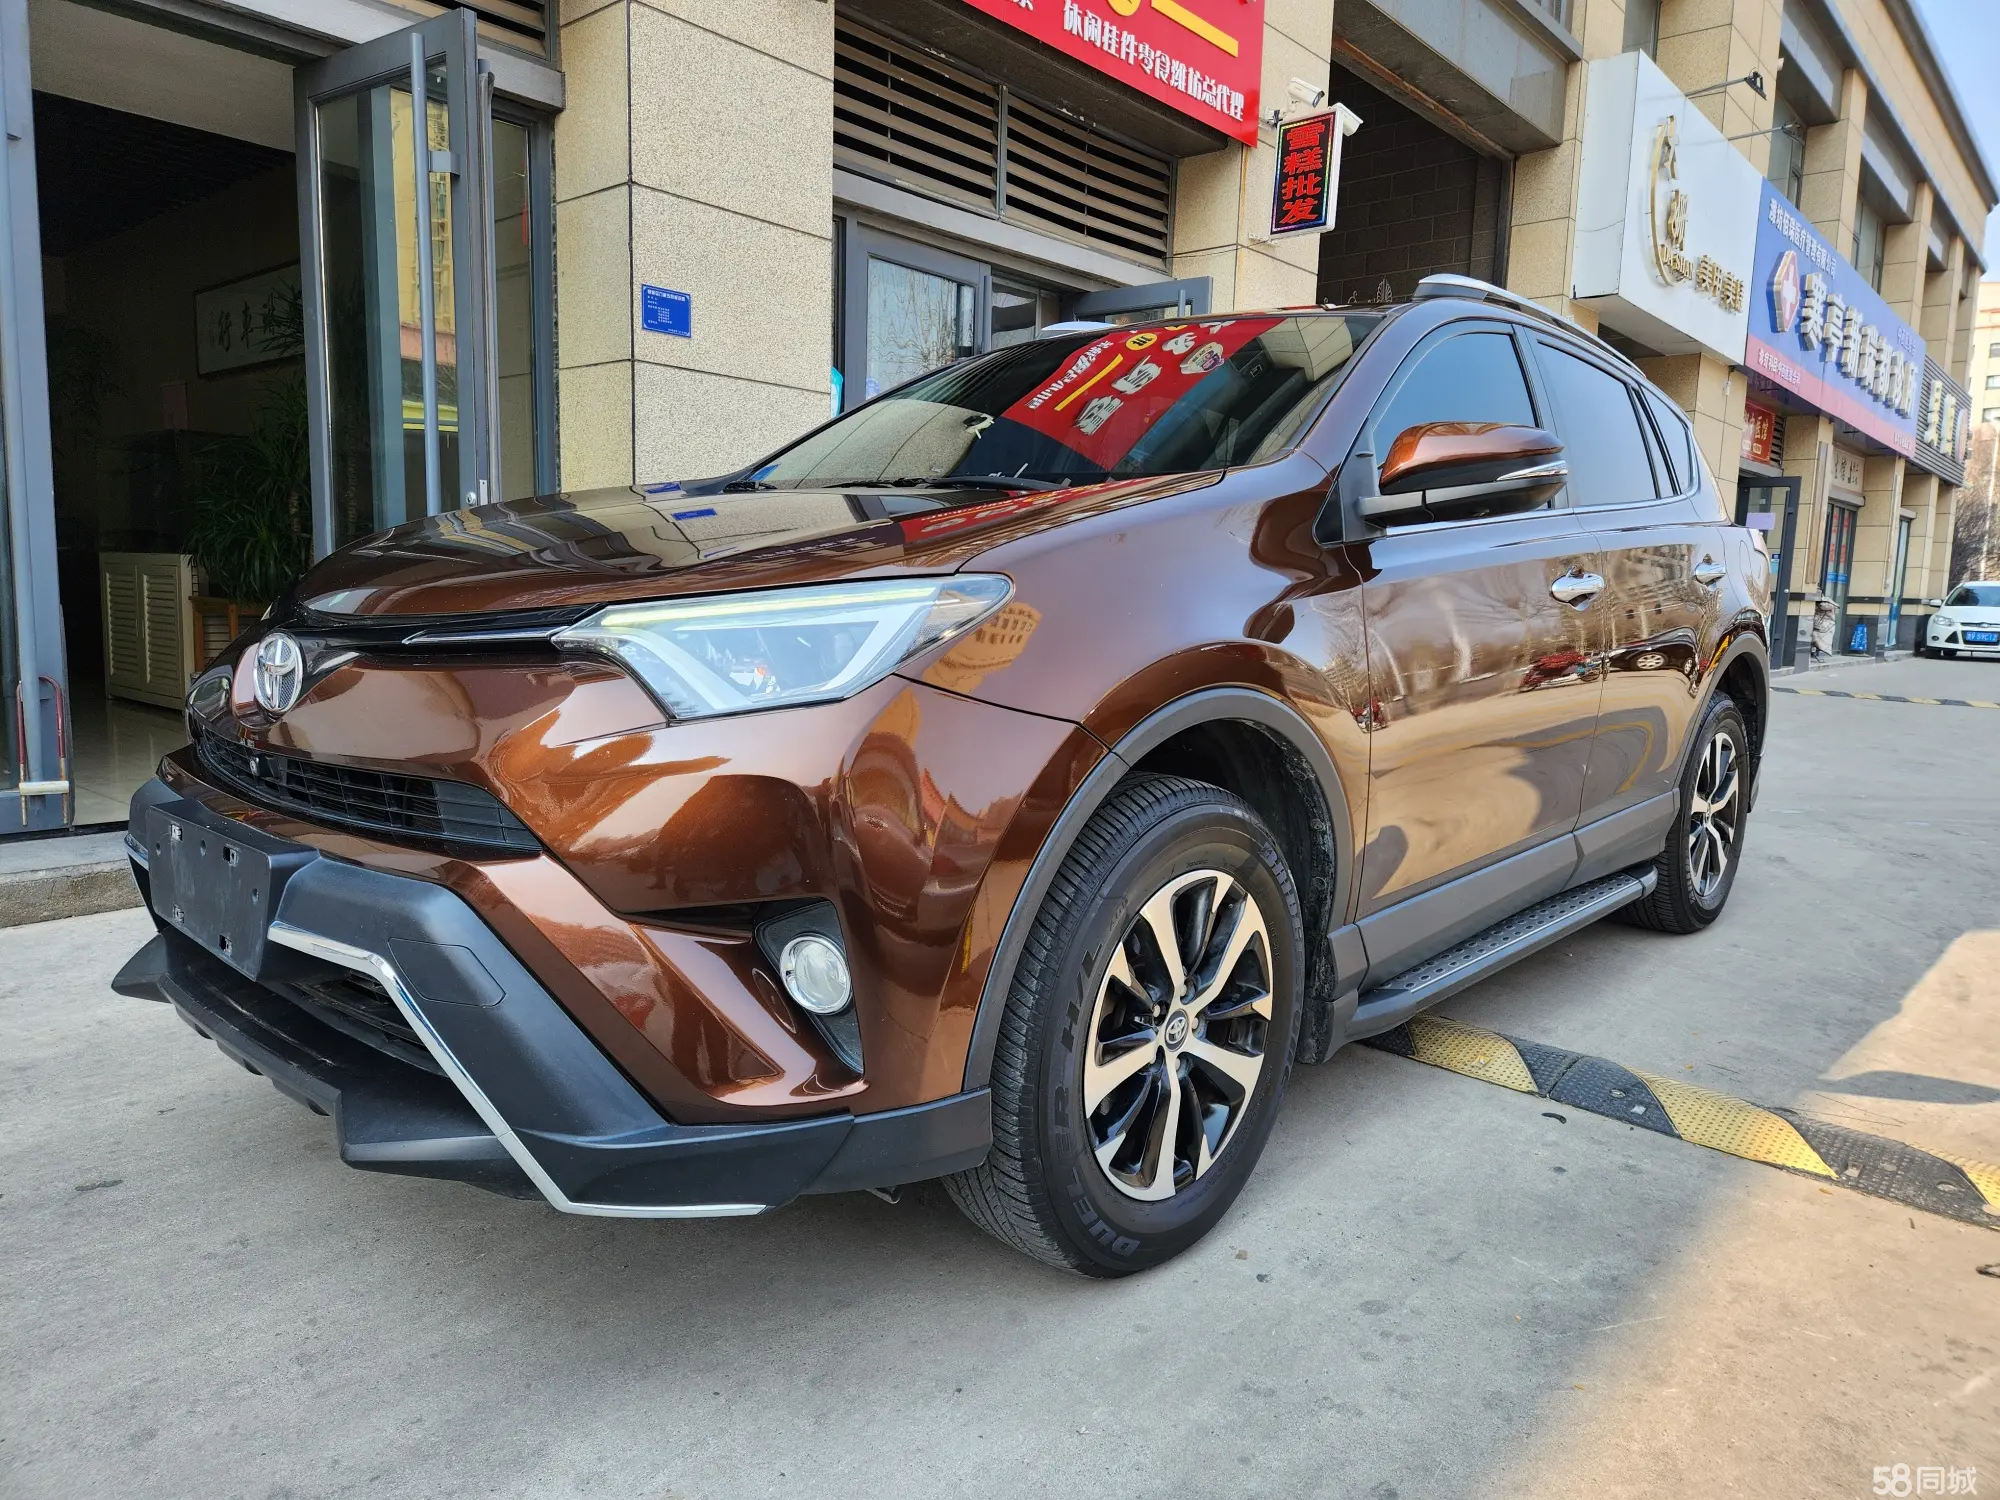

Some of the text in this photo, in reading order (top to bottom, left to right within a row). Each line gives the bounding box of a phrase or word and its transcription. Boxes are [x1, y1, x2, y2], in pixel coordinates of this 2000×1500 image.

[1063, 0, 1244, 122] 休闲挂件零食潍坊总代理
[1277, 122, 1325, 225] 雪糕批发
[1800, 272, 1918, 419] 寒亭新瑞都诊所
[1054, 1086, 1141, 1257] DUELER
